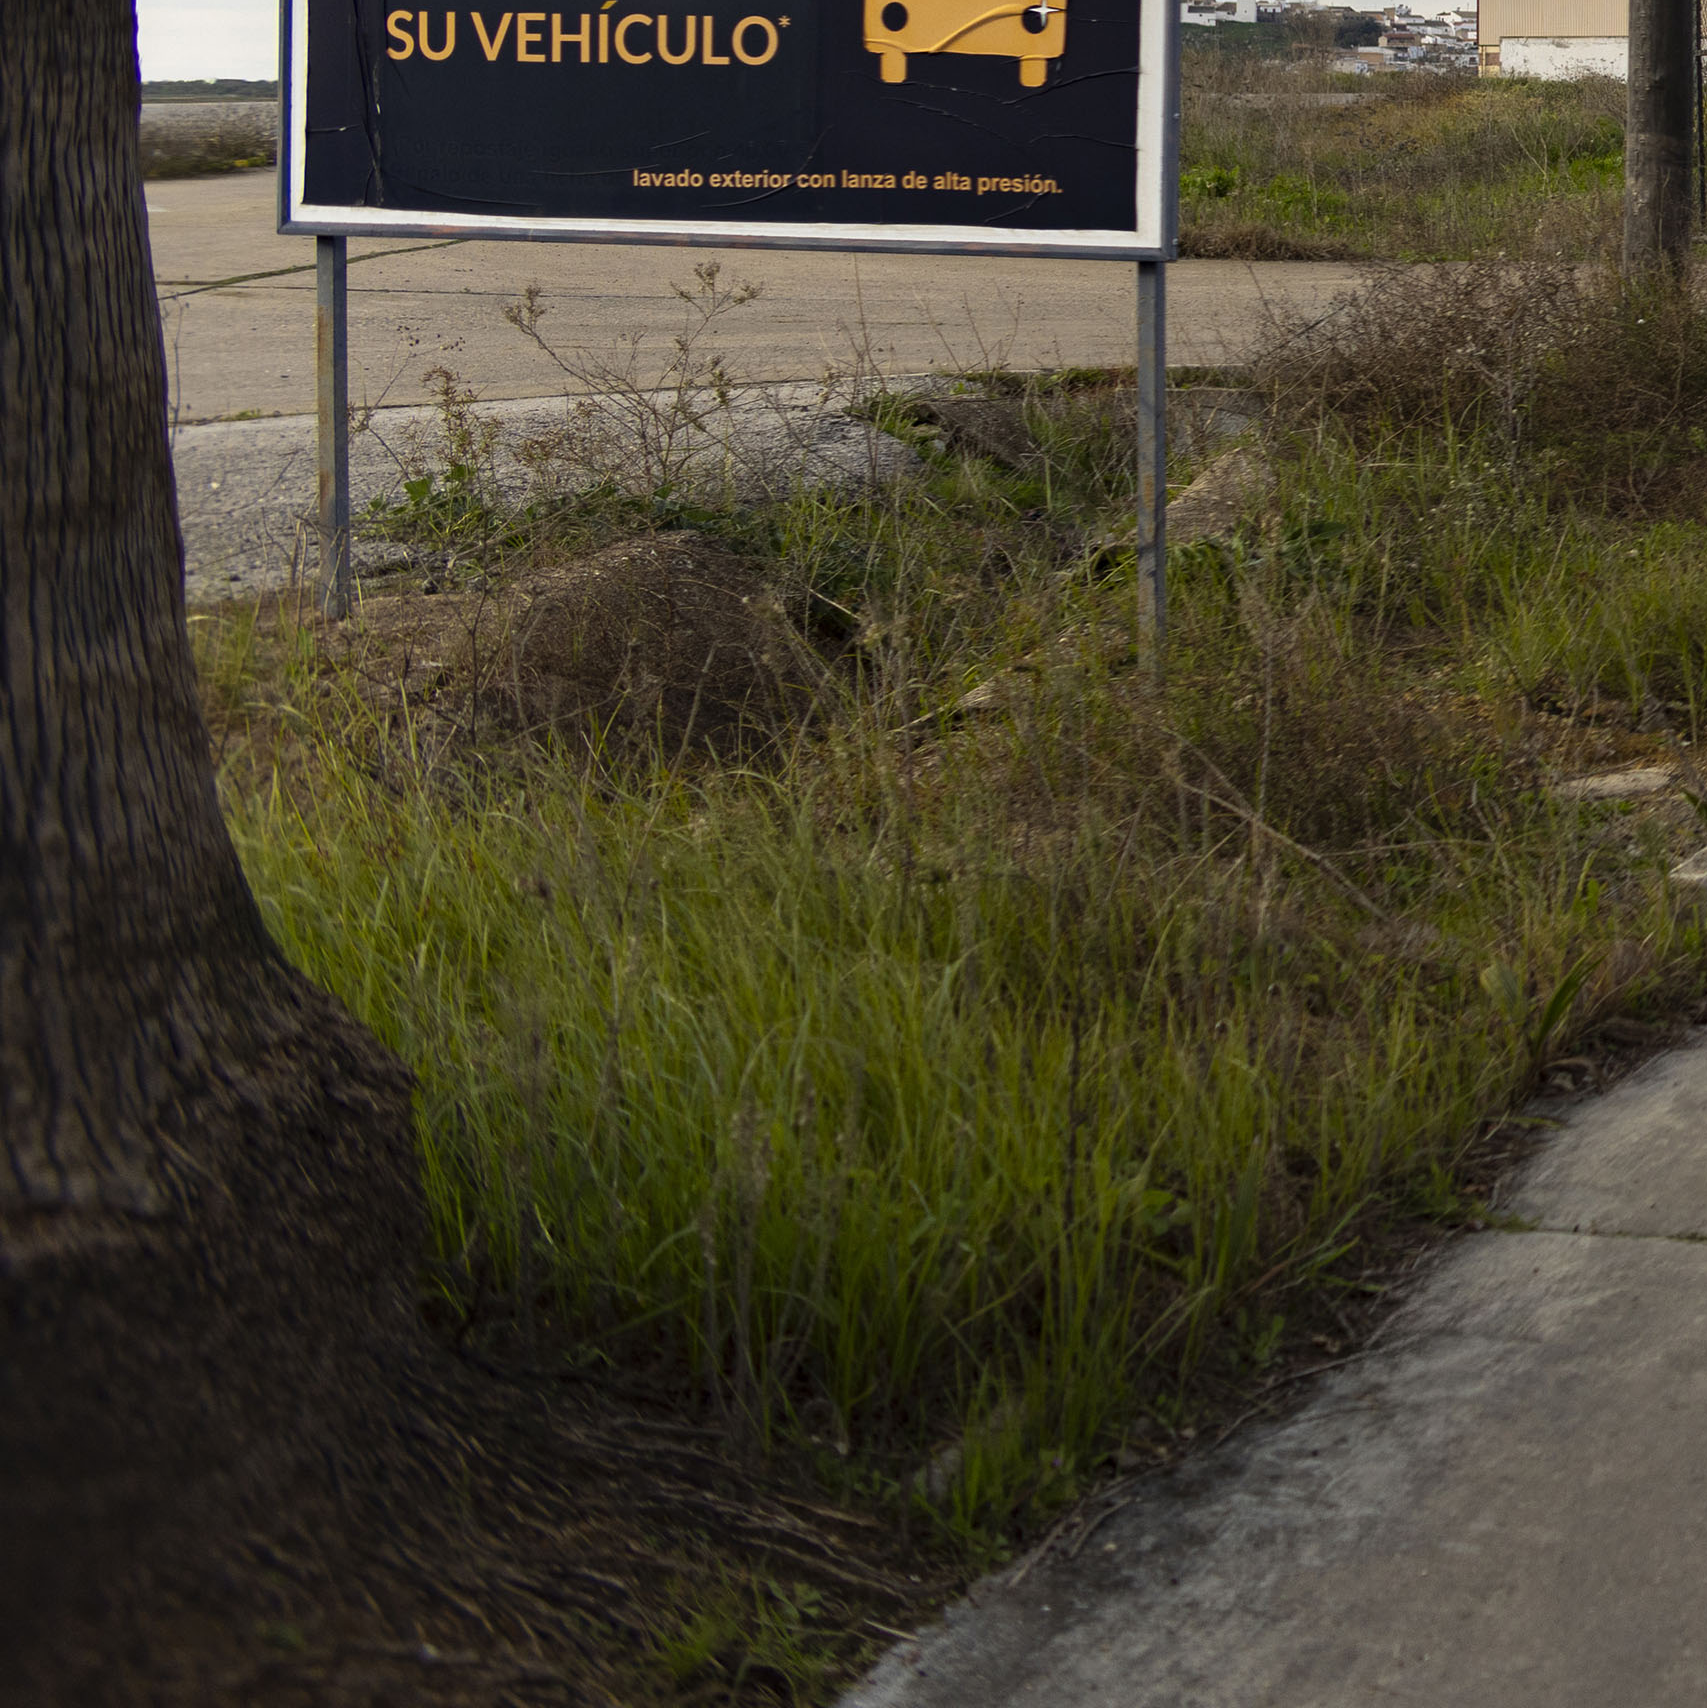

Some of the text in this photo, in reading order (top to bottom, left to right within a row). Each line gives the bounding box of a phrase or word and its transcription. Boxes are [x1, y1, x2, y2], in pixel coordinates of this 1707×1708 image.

[386, 10, 456, 61] SU
[633, 169, 1063, 195] lavado exterior con lanza de alta presión.
